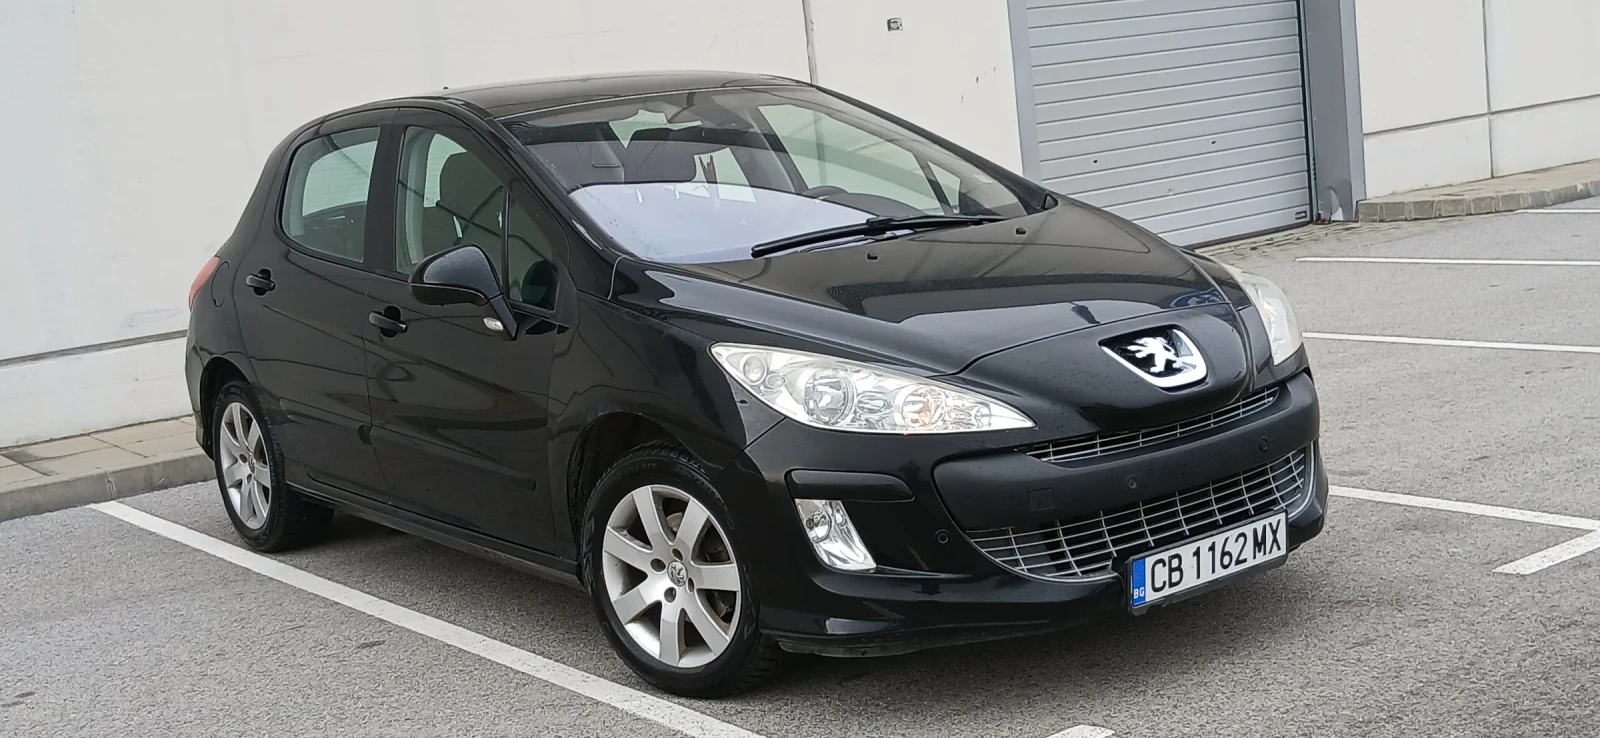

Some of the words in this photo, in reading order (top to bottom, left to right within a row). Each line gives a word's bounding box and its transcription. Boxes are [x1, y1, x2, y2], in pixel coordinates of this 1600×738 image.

[1151, 553, 1184, 593] CB
[1192, 531, 1248, 579] 1162
[1253, 518, 1281, 560] MX
[1133, 588, 1145, 600] BG
